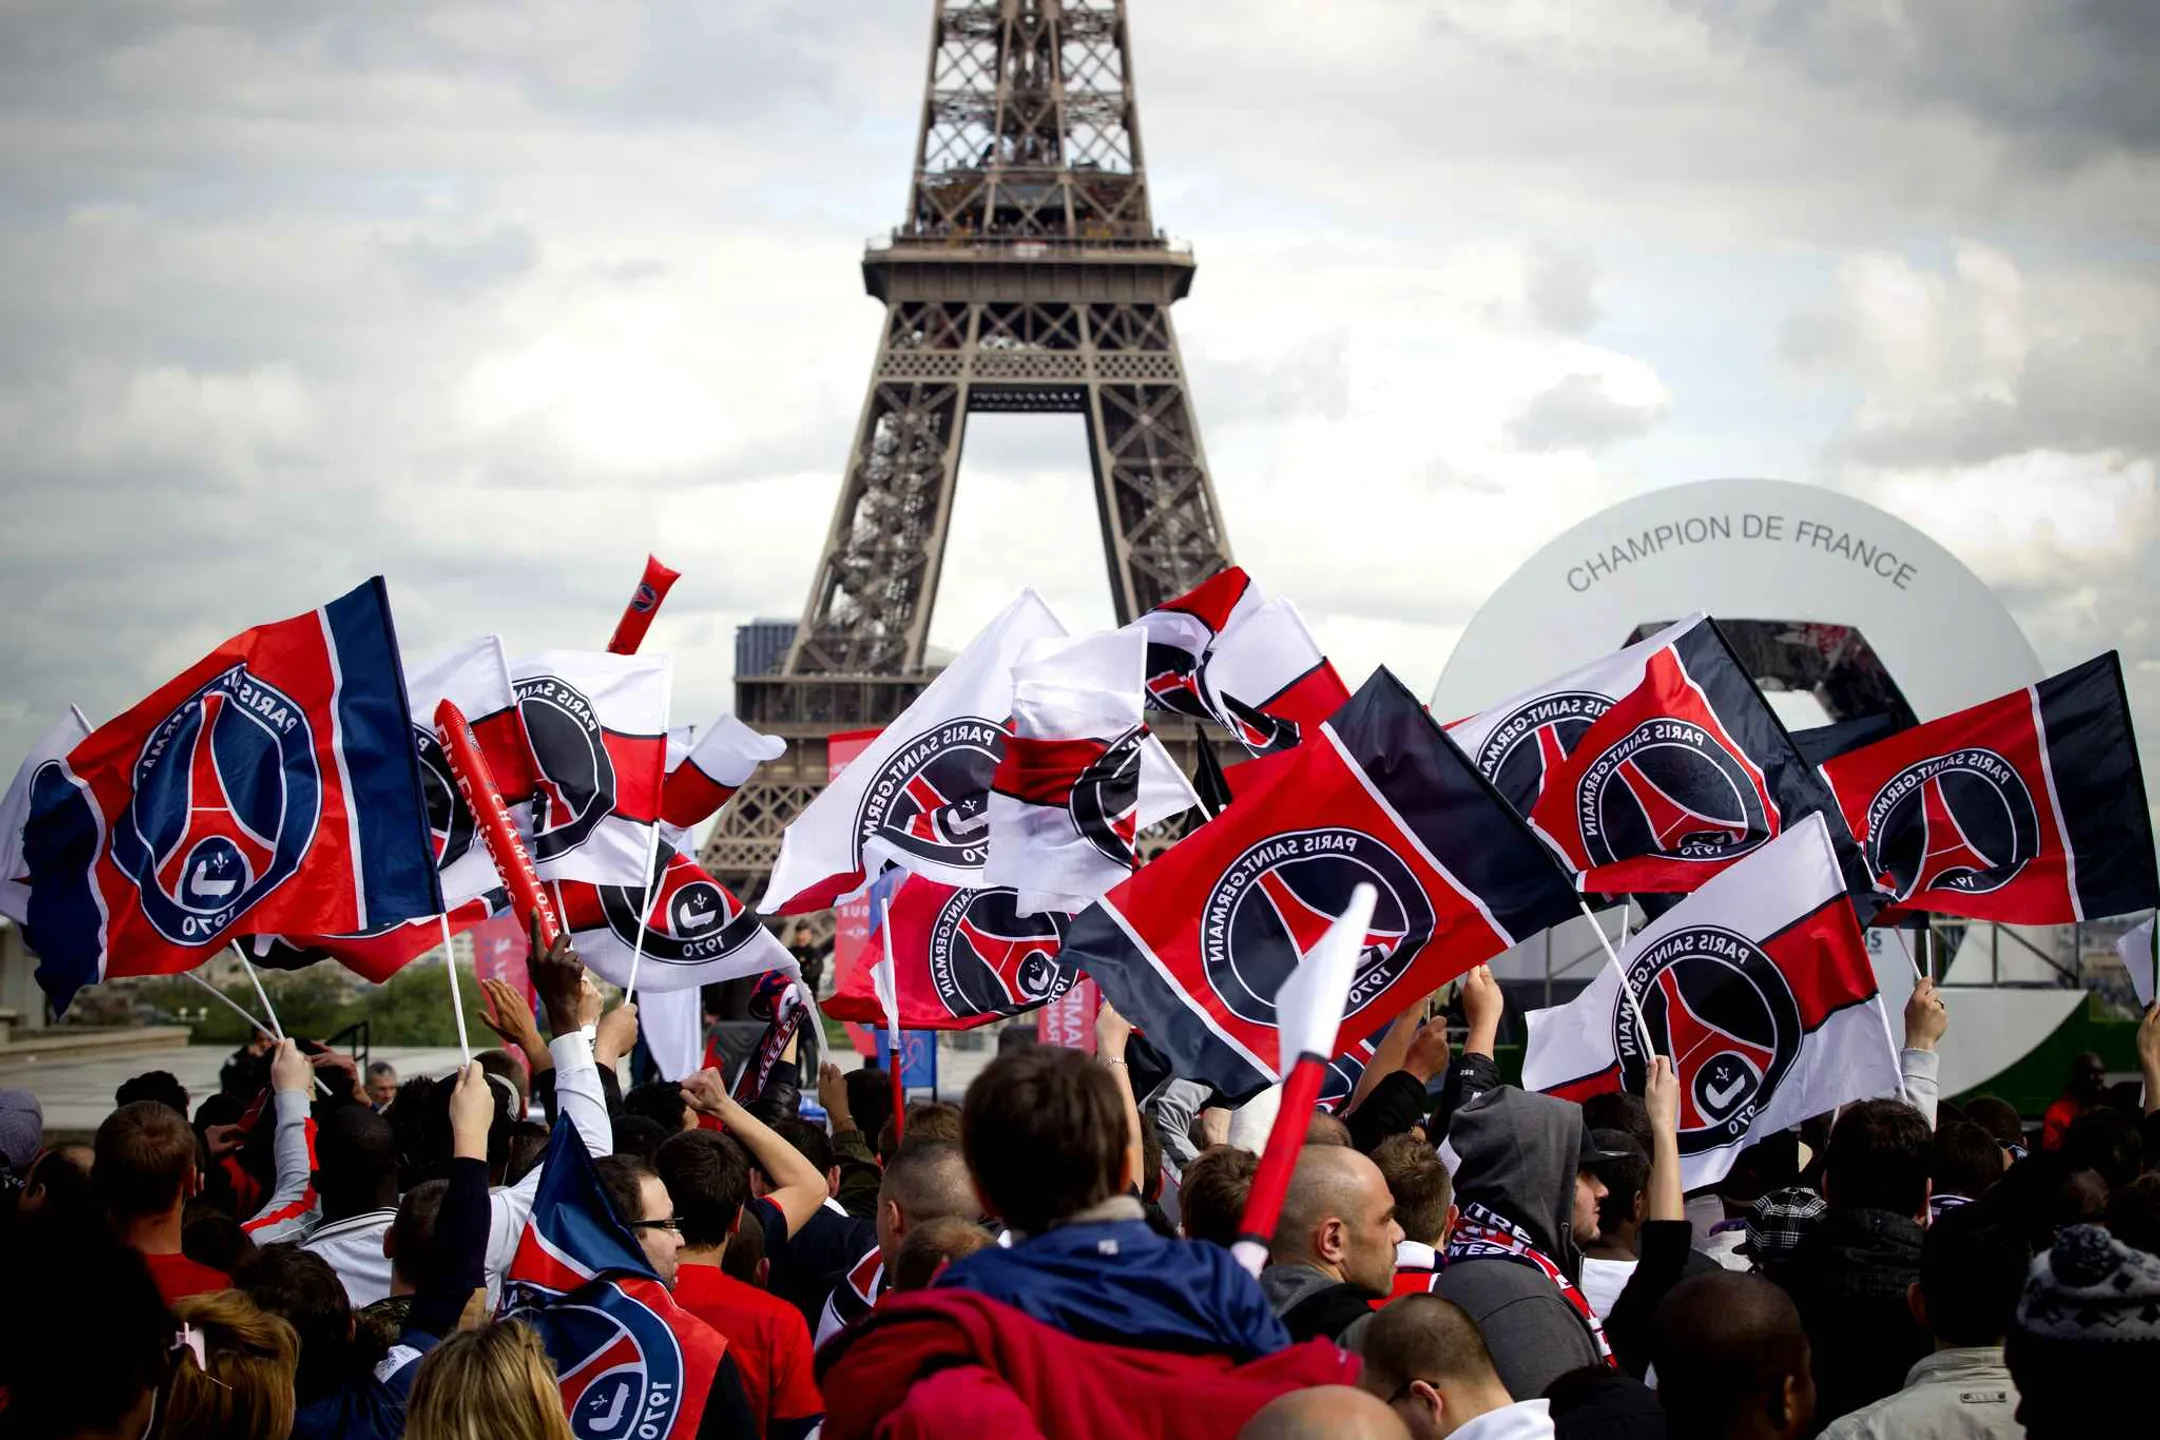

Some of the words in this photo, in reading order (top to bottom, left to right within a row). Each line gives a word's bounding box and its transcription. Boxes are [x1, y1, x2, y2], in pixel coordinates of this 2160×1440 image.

[1567, 515, 1731, 592] CHAMPION
[1743, 514, 1784, 541] DE
[1795, 520, 1917, 591] FRANCE
[492, 793, 562, 939] CHAMPIONS
